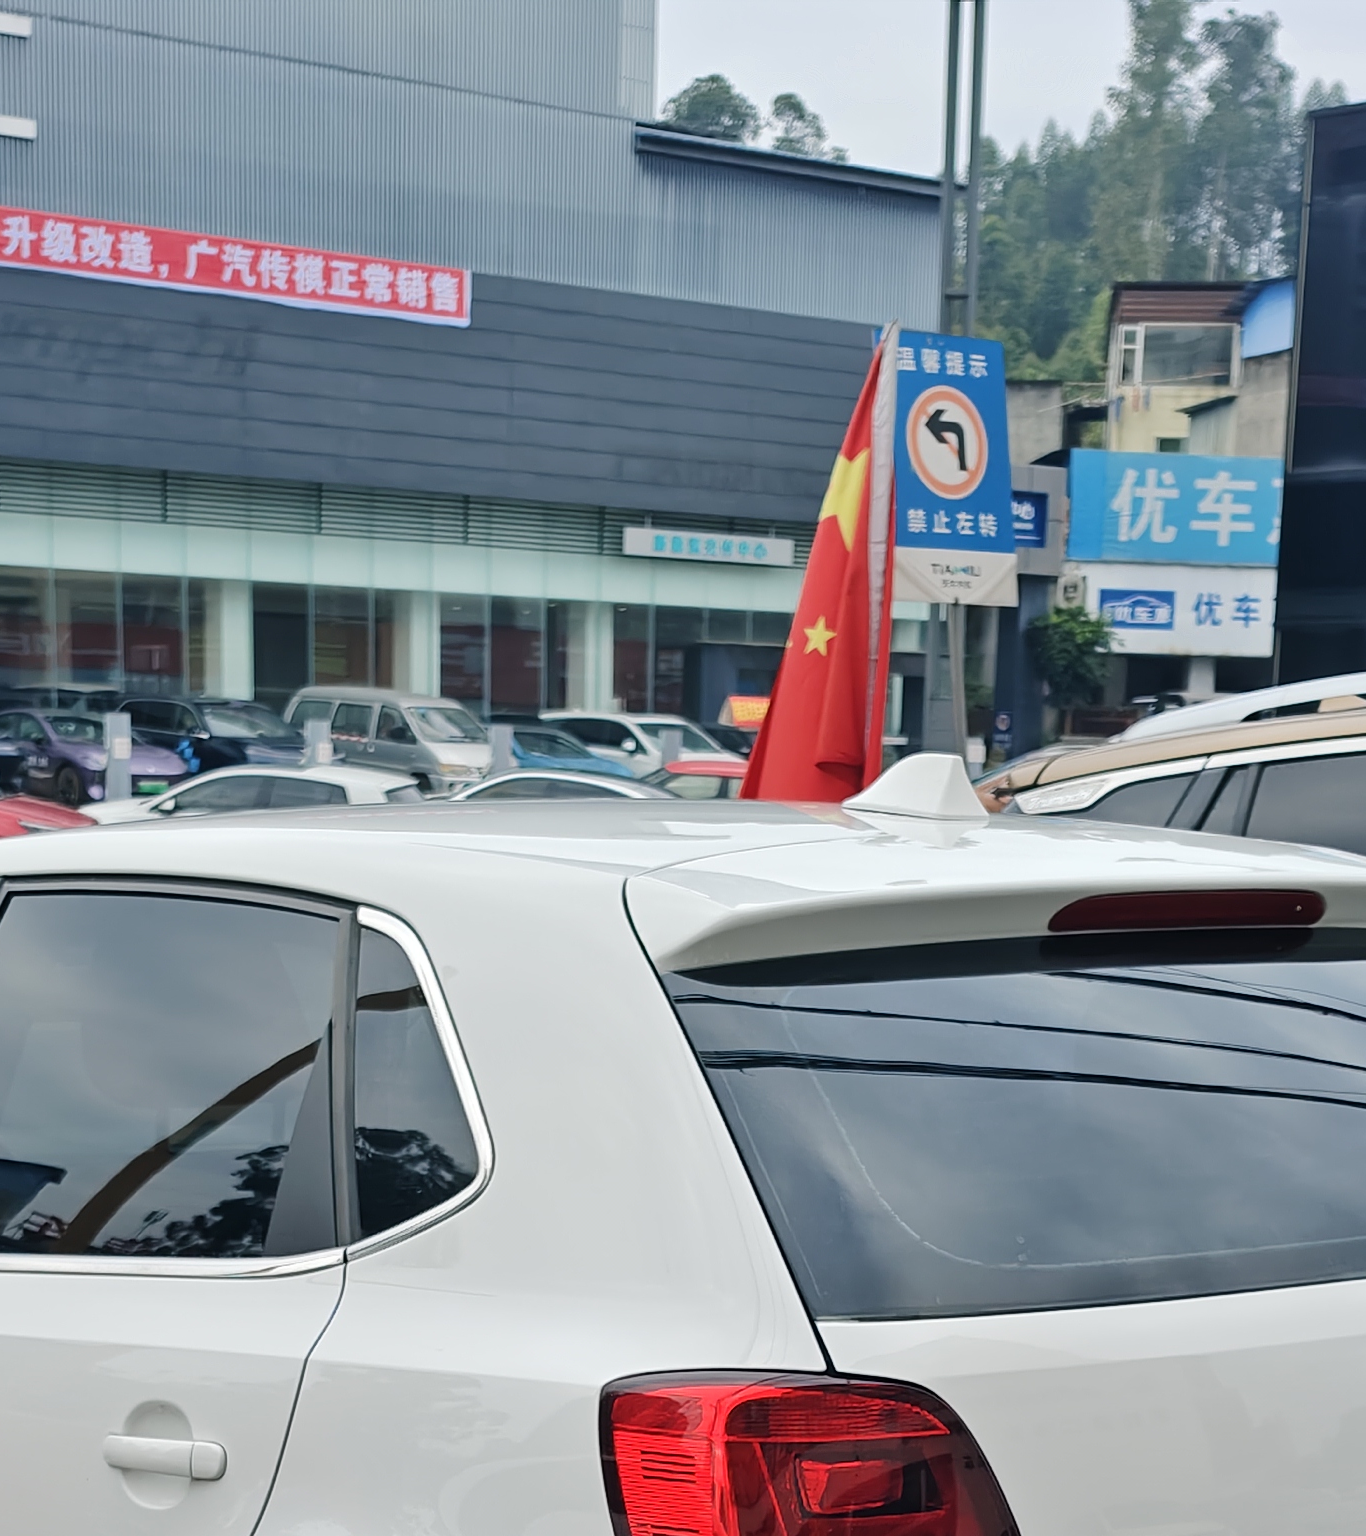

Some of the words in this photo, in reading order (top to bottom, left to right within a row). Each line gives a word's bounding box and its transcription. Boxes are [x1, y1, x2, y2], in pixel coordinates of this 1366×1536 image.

[907, 508, 998, 538] 禁止左转
[1111, 468, 1283, 547] 优车
